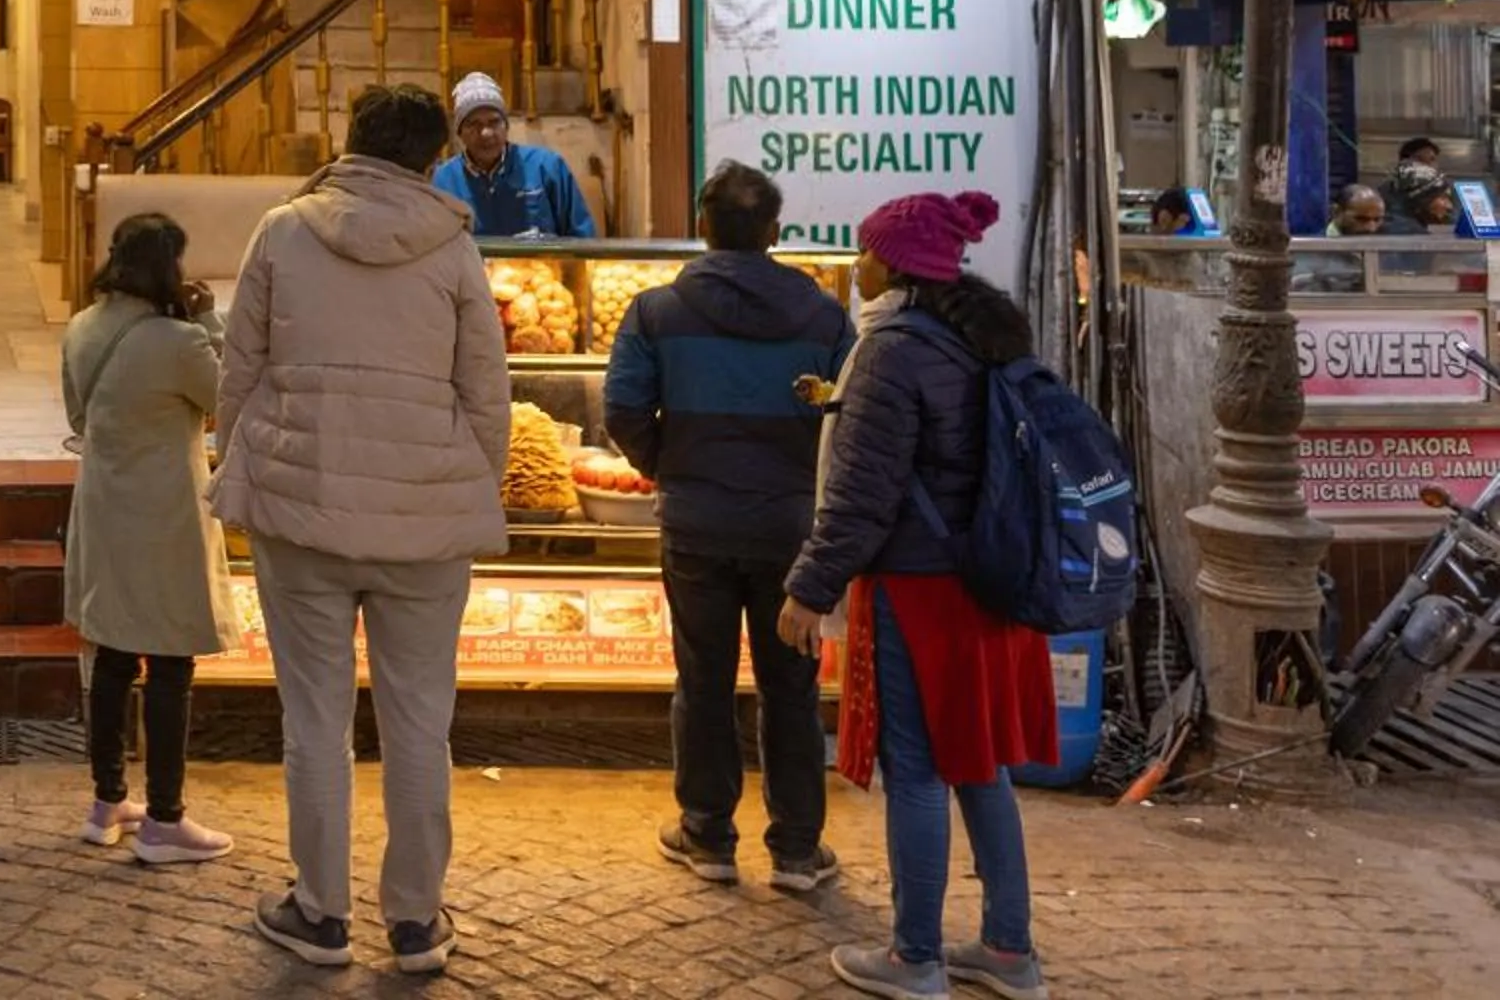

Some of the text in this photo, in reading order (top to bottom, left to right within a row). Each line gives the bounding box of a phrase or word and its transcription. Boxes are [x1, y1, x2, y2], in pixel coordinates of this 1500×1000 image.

[727, 75, 1016, 115] NORTH INDIAN
[761, 132, 982, 173] SPECIALITY
[1326, 330, 1469, 378] SWEETS
[1299, 437, 1472, 457] BREAD PAKORA
[1442, 460, 1500, 479] JAMU
